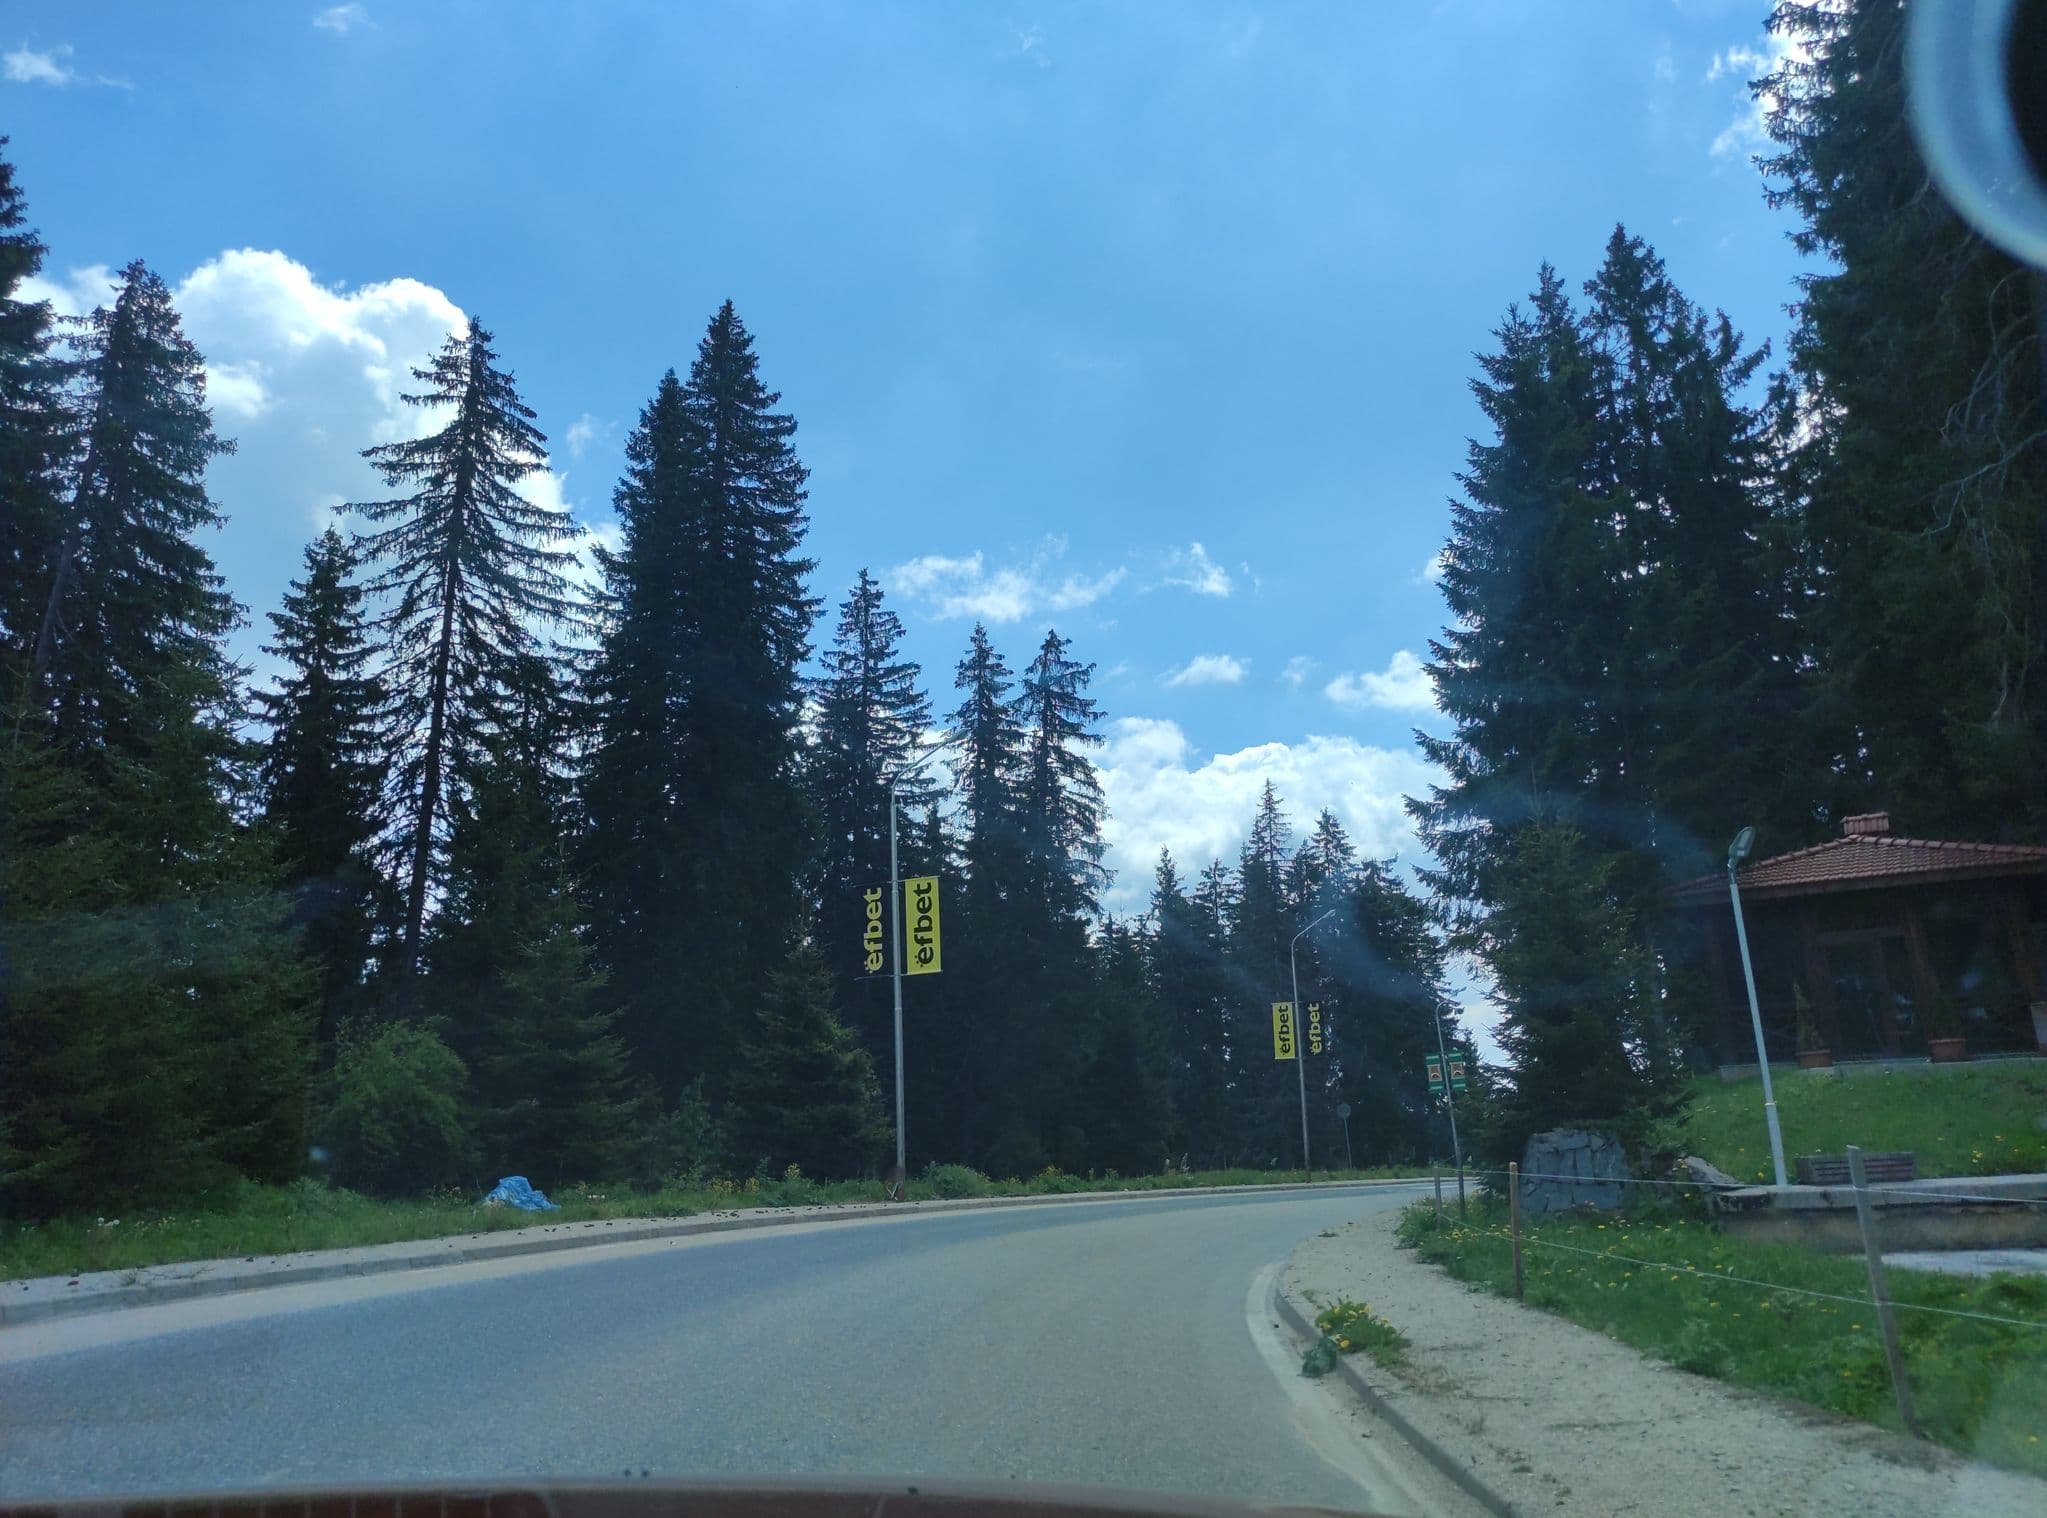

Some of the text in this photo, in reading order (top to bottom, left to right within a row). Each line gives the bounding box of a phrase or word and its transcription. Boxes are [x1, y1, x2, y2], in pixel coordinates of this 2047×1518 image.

[863, 887, 883, 974] efbet
[913, 882, 934, 968] efbet
[1278, 1005, 1291, 1056] efbet
[1307, 1003, 1323, 1056] efbet
